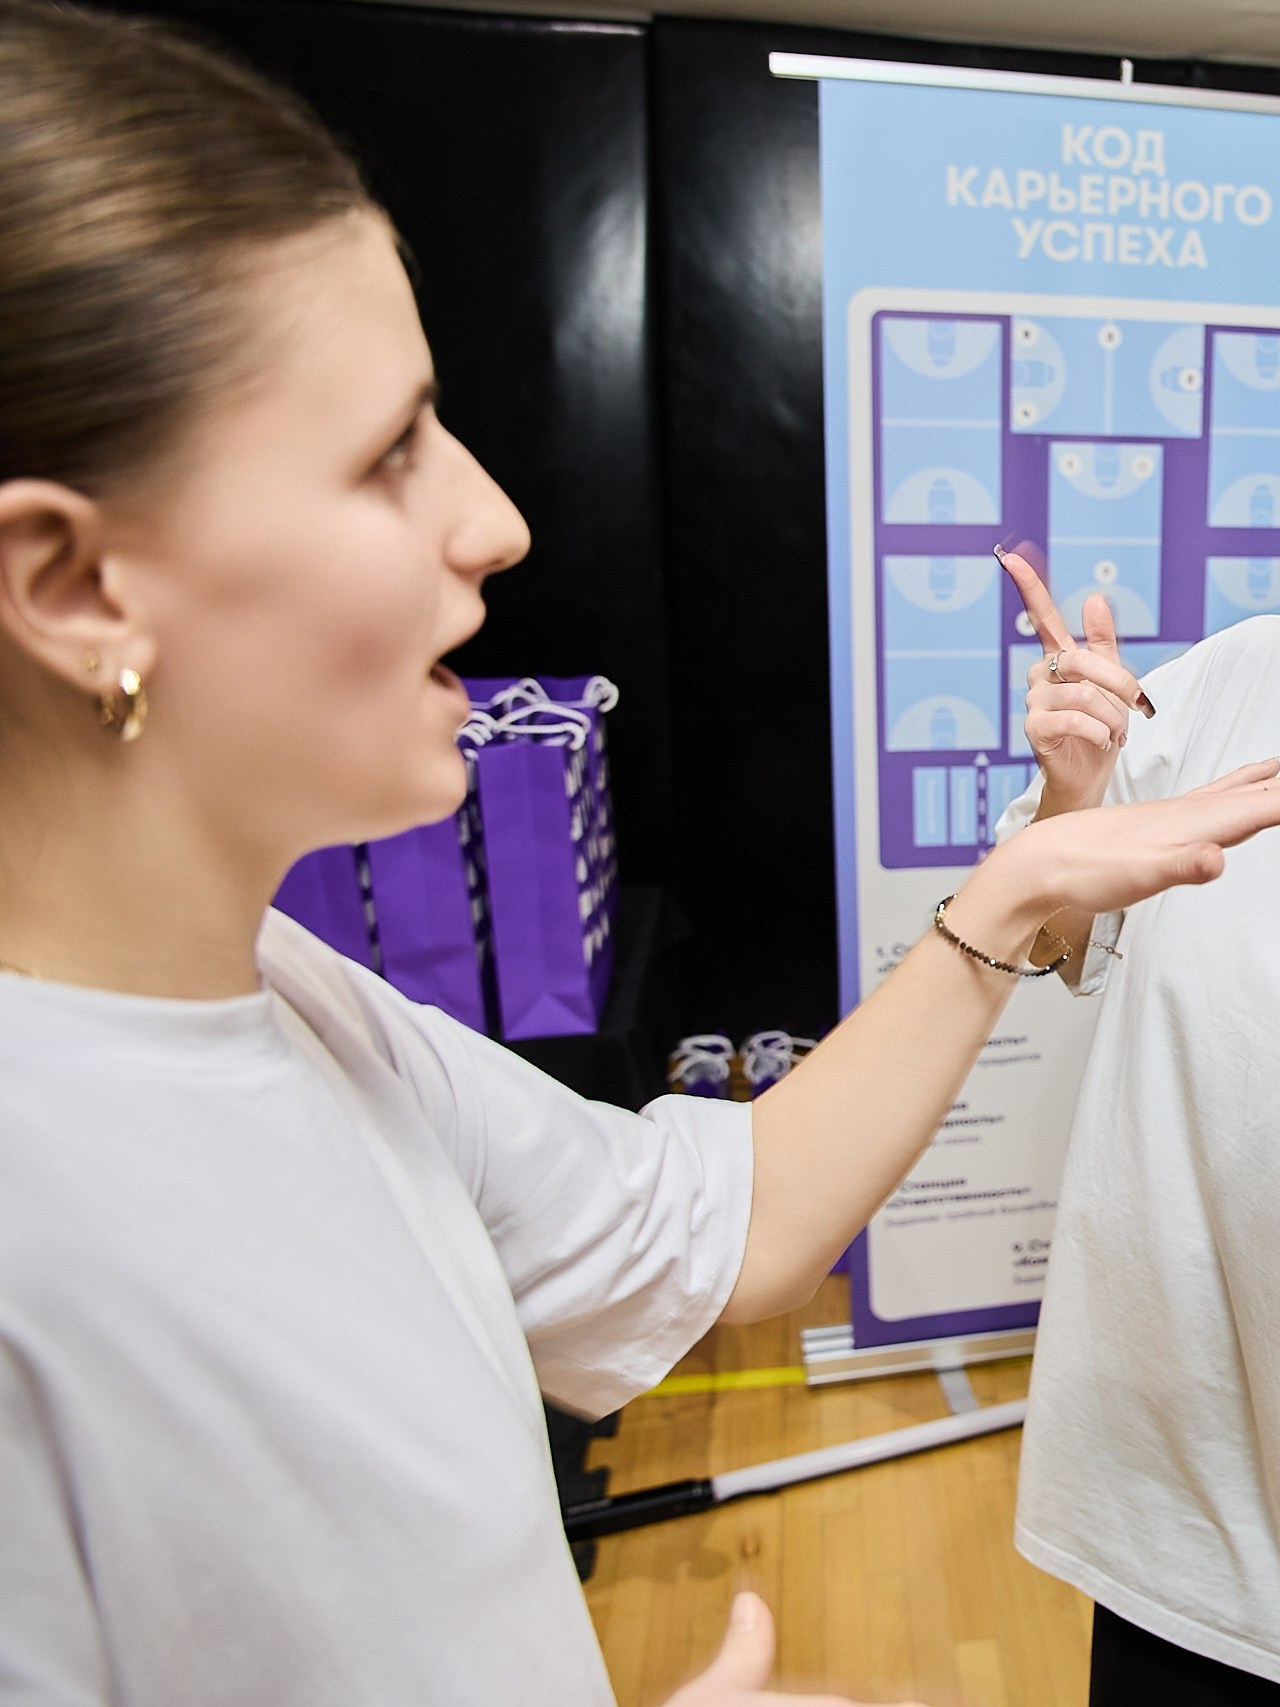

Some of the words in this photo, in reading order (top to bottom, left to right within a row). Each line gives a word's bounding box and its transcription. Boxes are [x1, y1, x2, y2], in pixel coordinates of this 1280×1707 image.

[1061, 123, 1167, 177] КОД
[946, 165, 1273, 227] КАРЬЕРНОГО
[1011, 217, 1208, 269] УСПЕХА
